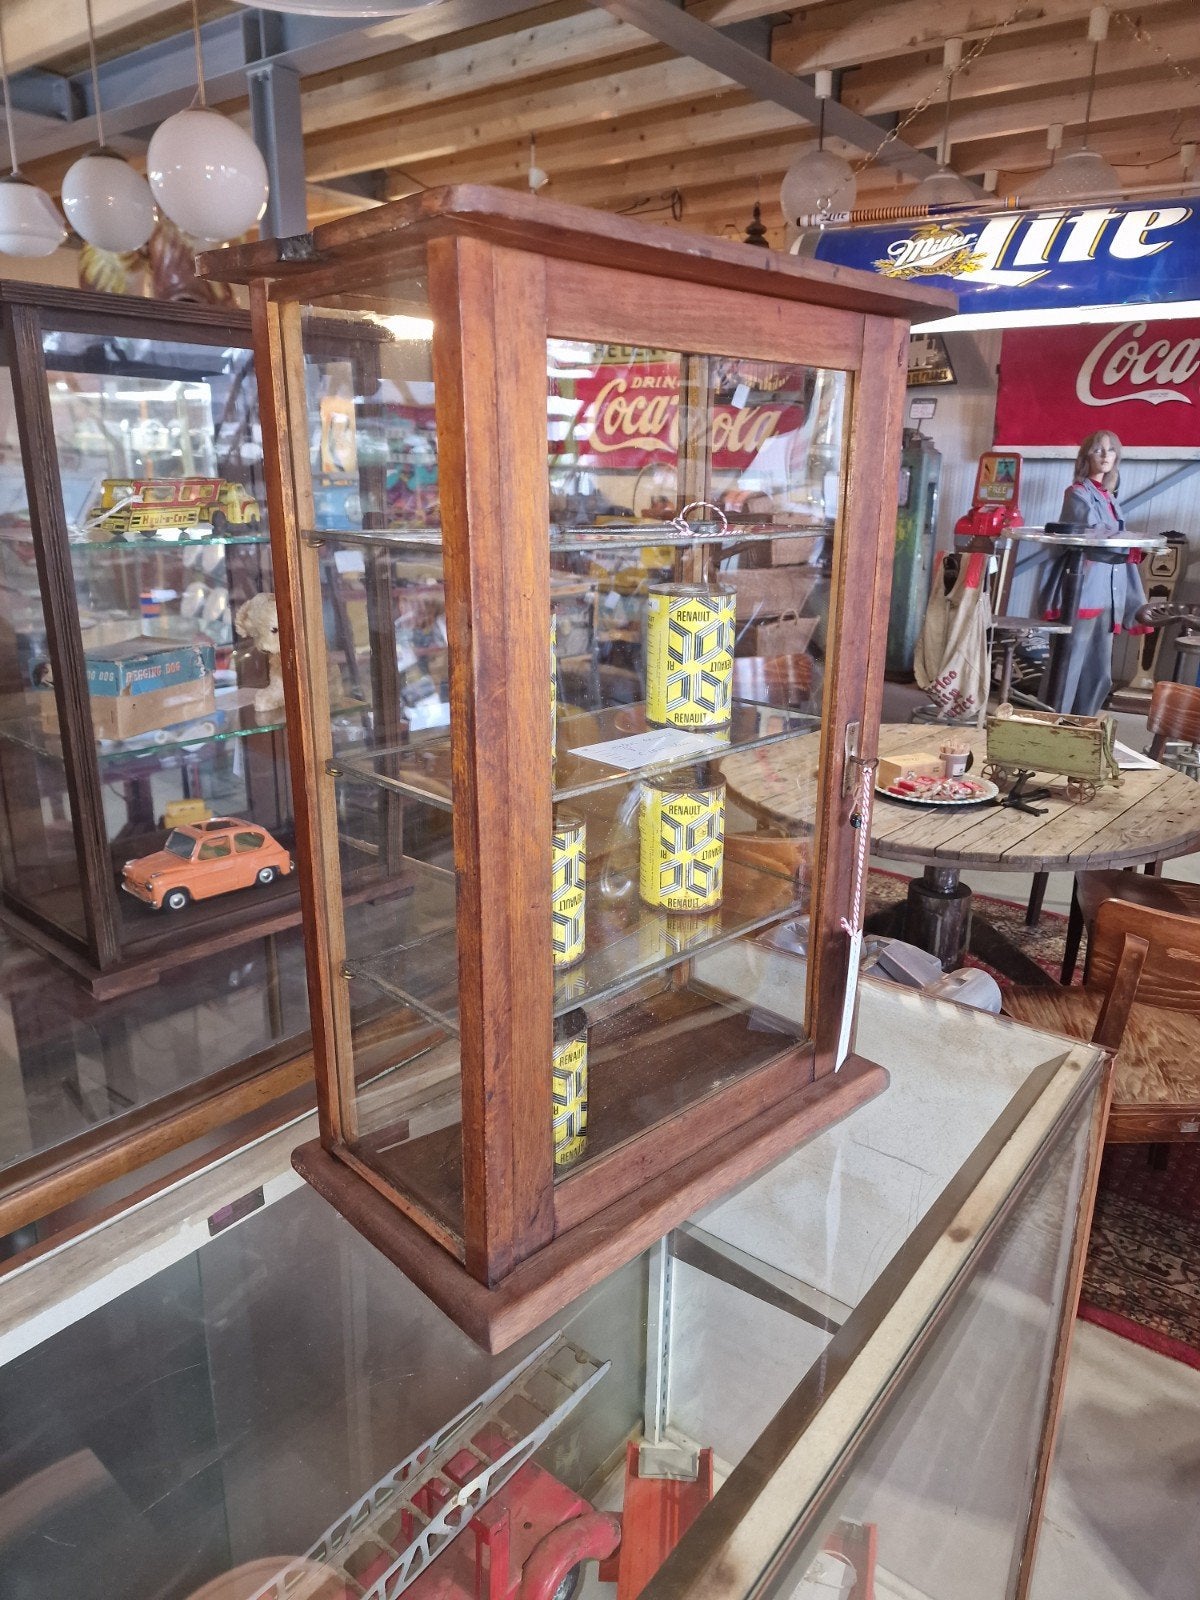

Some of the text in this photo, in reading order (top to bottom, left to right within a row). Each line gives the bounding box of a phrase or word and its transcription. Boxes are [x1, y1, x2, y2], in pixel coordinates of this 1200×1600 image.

[886, 232, 978, 272] Miller
[953, 207, 1193, 287] Lite
[629, 375, 681, 389] DRIN
[676, 610, 711, 622] RENAULT
[674, 712, 707, 724] RENAULT
[668, 804, 701, 816] RENAULT
[667, 897, 700, 909] RENAULT
